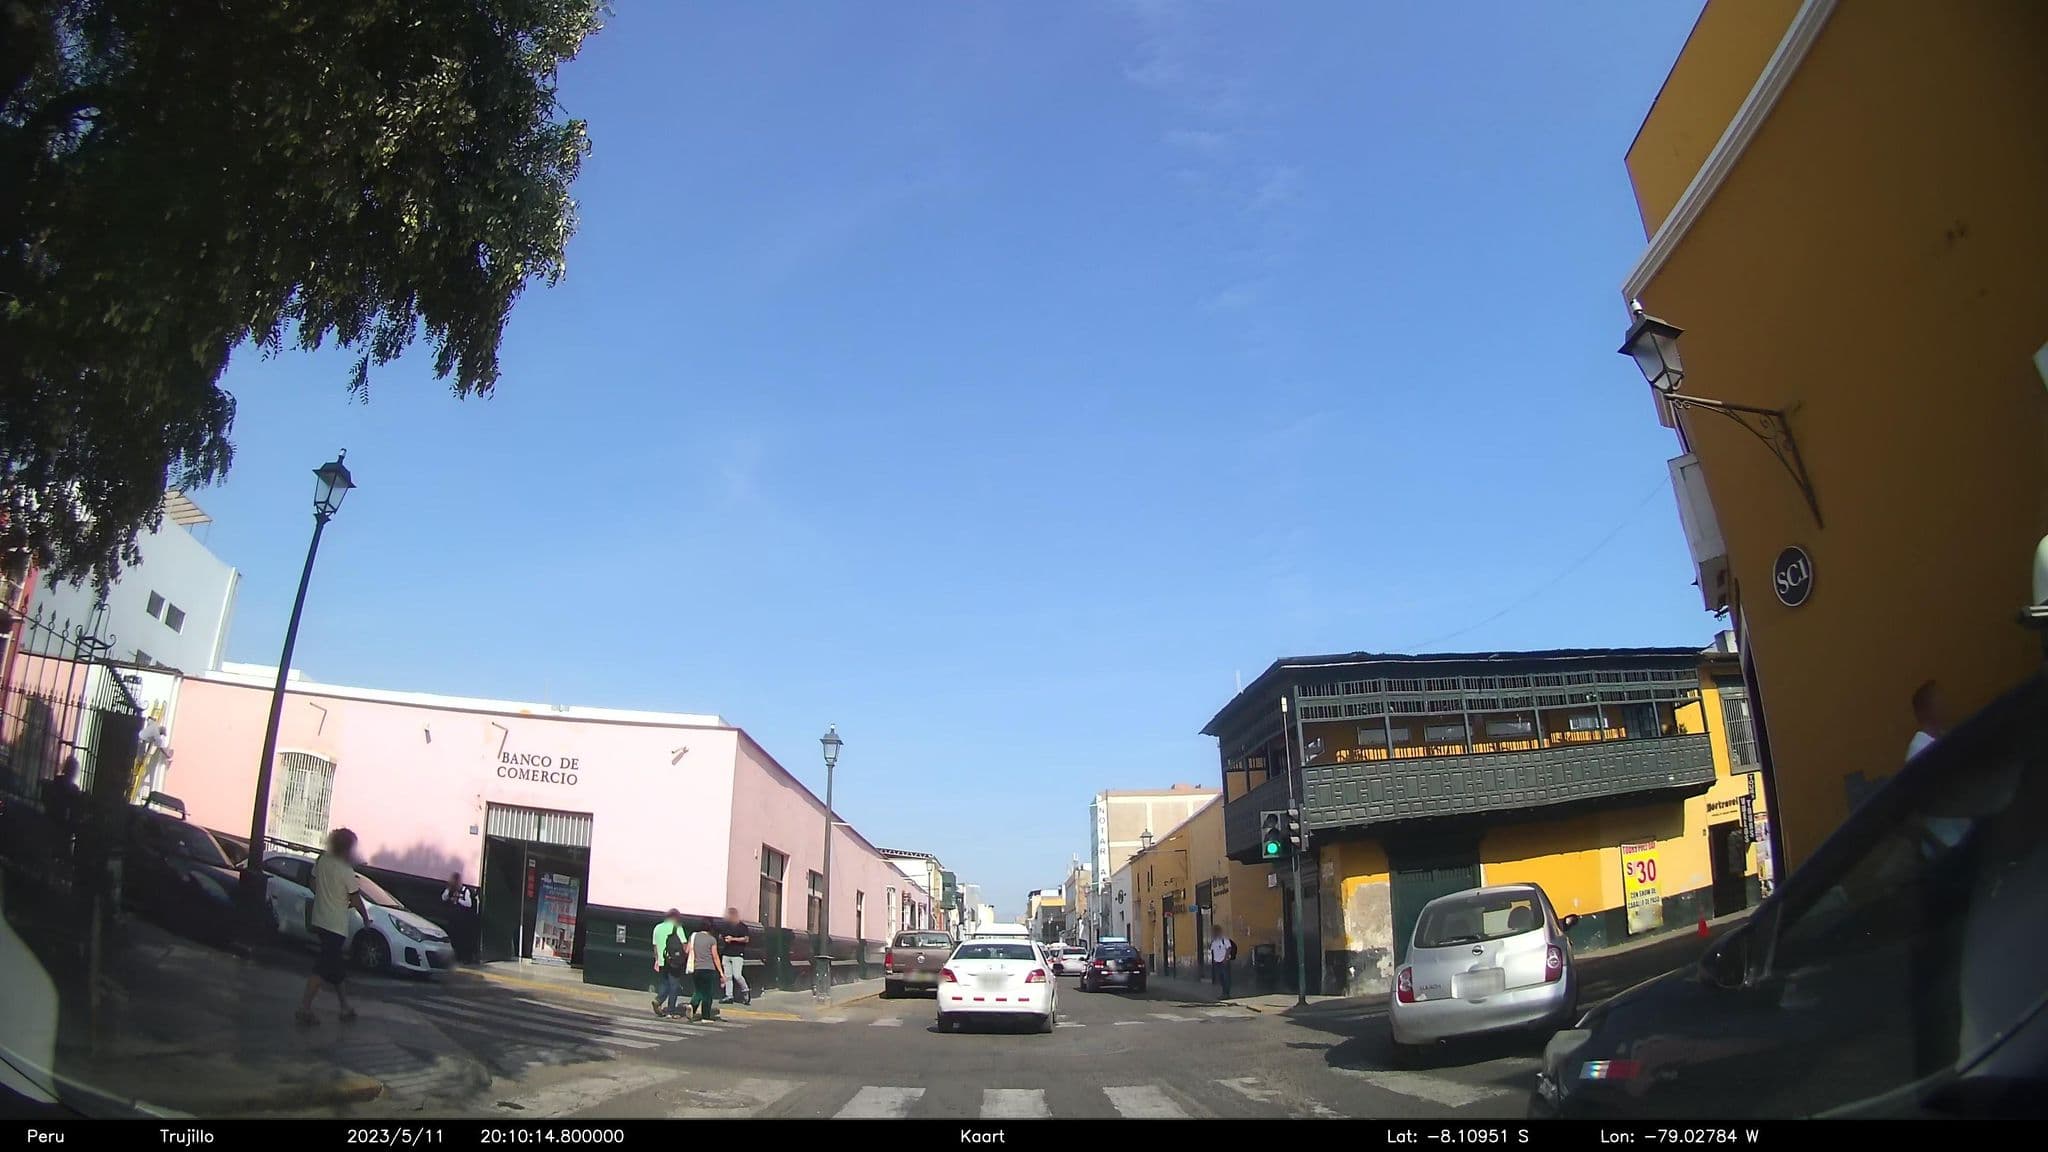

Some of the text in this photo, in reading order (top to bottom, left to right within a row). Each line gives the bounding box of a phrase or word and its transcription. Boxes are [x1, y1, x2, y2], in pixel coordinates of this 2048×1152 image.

[1777, 558, 1808, 594] SCI
[502, 751, 580, 770] BANCO DE
[497, 766, 578, 786] COMERCIO
